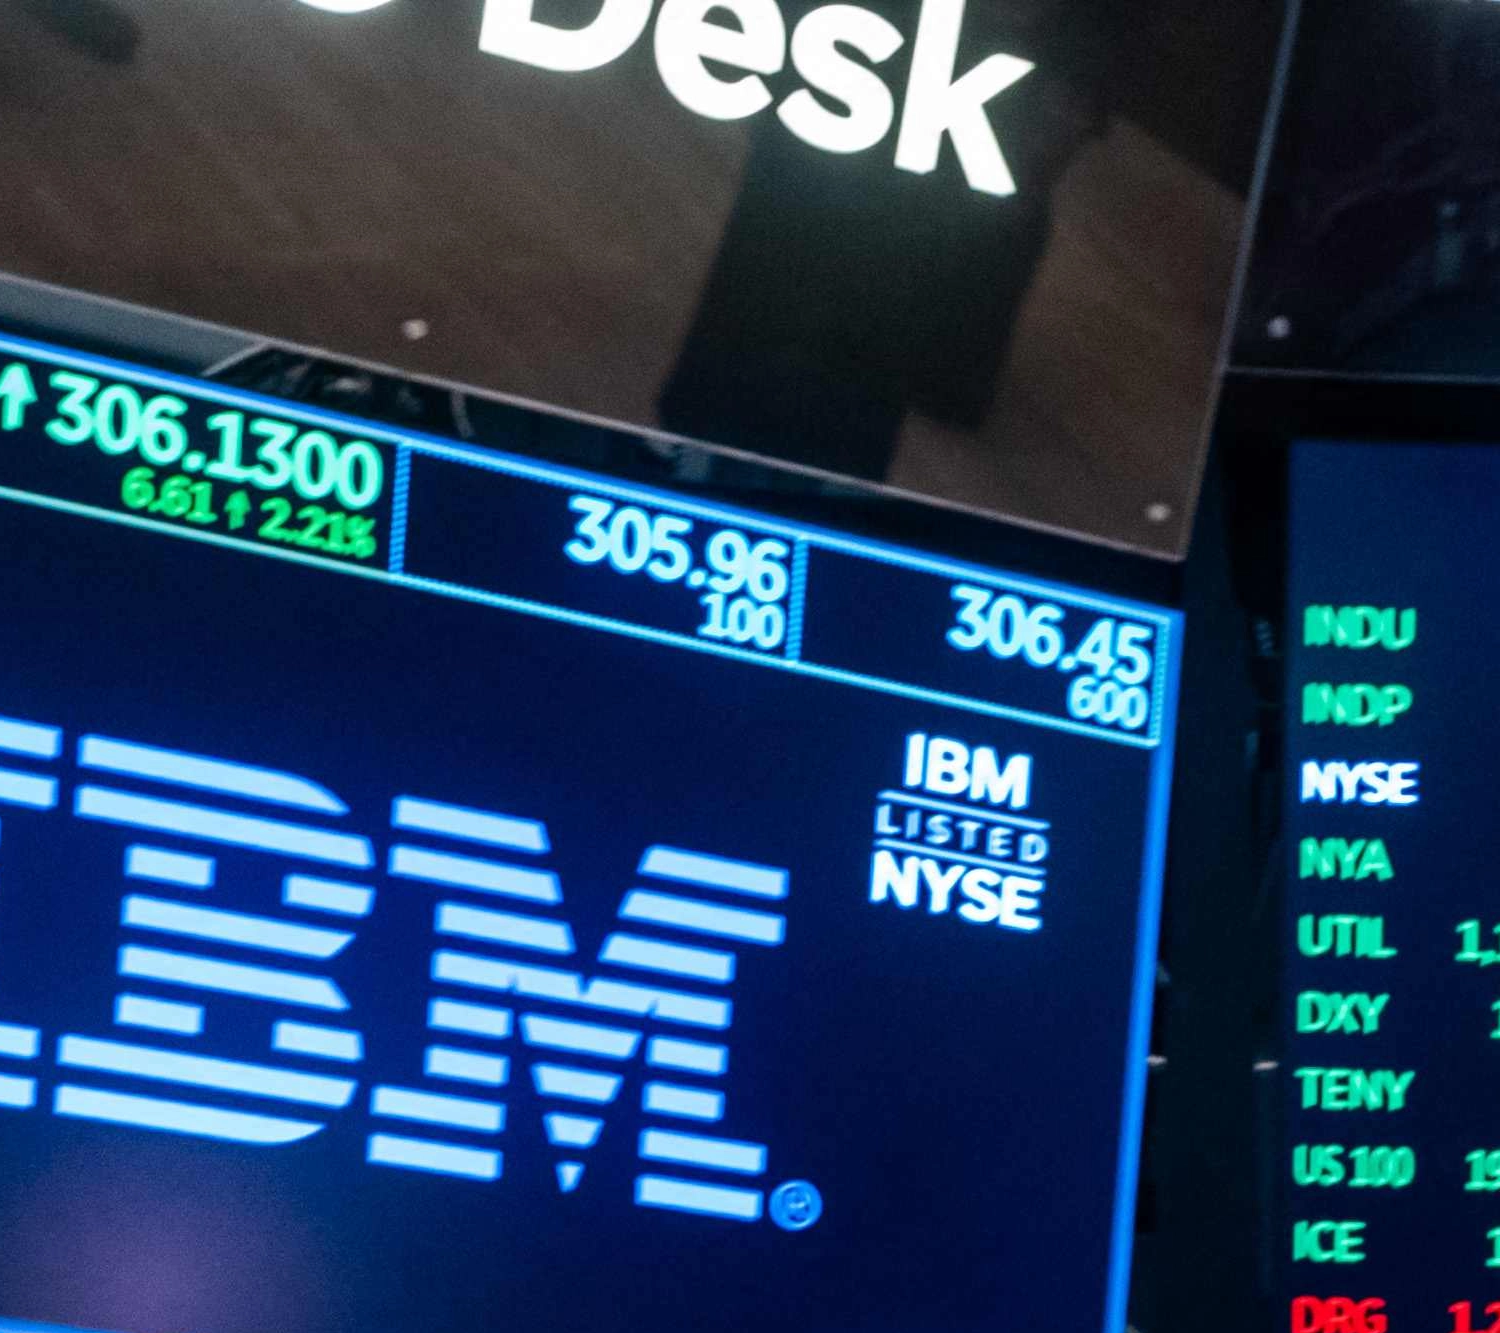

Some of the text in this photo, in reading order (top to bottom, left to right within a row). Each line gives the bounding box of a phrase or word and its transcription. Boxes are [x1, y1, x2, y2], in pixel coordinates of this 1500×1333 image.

[46, 371, 384, 509] 306.1300
[121, 466, 217, 524] 6.61
[257, 497, 377, 558] 2.21%
[565, 494, 789, 601] 305.96
[699, 593, 784, 651] 100
[948, 585, 1152, 687] 306.45
[1302, 606, 1417, 649] INDU
[1067, 676, 1149, 731] 600
[1301, 683, 1414, 726] INDP
[903, 732, 1032, 810] IBM
[1300, 760, 1421, 806] NYSE
[874, 805, 1049, 865] LISTED
[1299, 837, 1394, 881] NYA
[869, 849, 1046, 931] NYSE
[1297, 915, 1398, 959] UTIL
[1296, 991, 1391, 1035] DXY
[1294, 1066, 1415, 1111] TENY
[1291, 1143, 1346, 1187] US
[1348, 1144, 1416, 1188] 100
[1292, 1219, 1368, 1264] ICE
